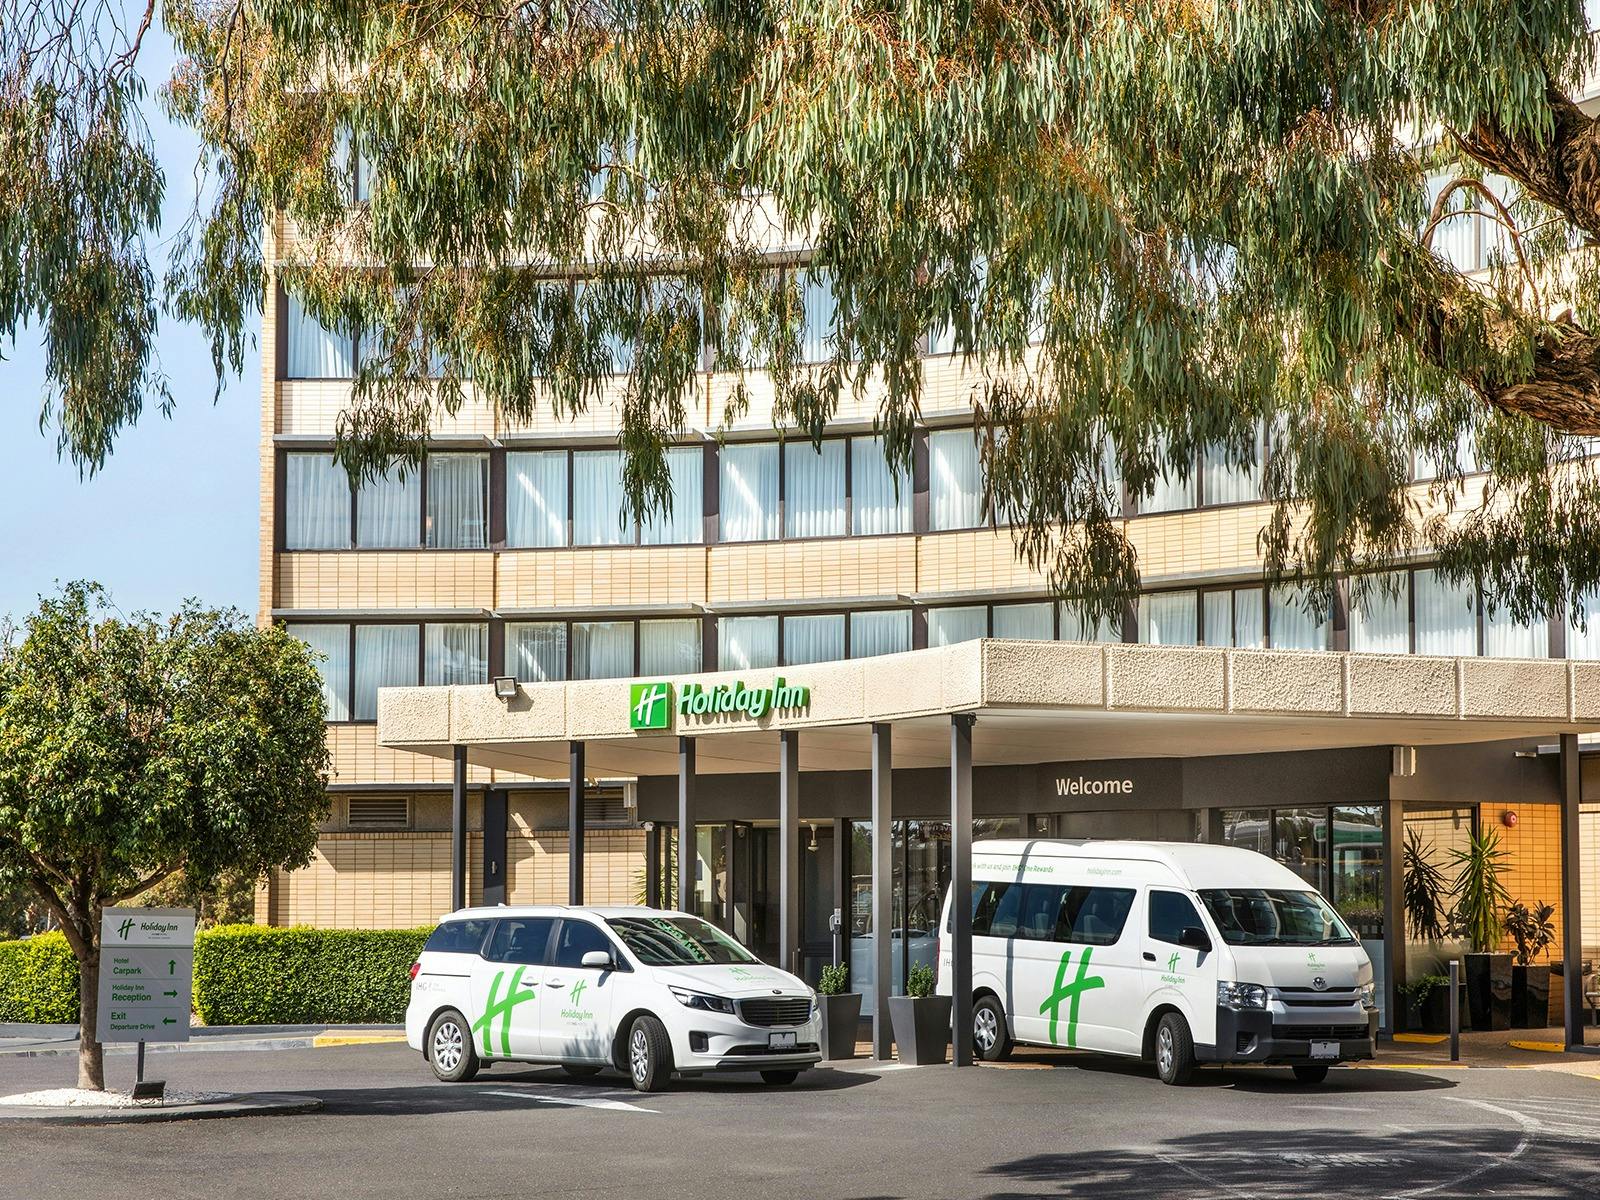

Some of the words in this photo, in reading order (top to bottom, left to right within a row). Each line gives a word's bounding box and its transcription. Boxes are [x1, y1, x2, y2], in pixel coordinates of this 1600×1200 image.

[677, 680, 772, 718] Holiday
[770, 676, 810, 709] Inn
[1056, 776, 1133, 796] Welcome
[140, 921, 167, 933] Holiday
[166, 922, 178, 931] Inn
[113, 966, 142, 976] Carpark
[112, 984, 134, 992] Holiday
[112, 993, 152, 1003] Reception
[111, 1012, 126, 1020] Exit
[561, 1009, 583, 1020] Holiday
[583, 1010, 593, 1019] Inn
[110, 1023, 139, 1031] Departure
